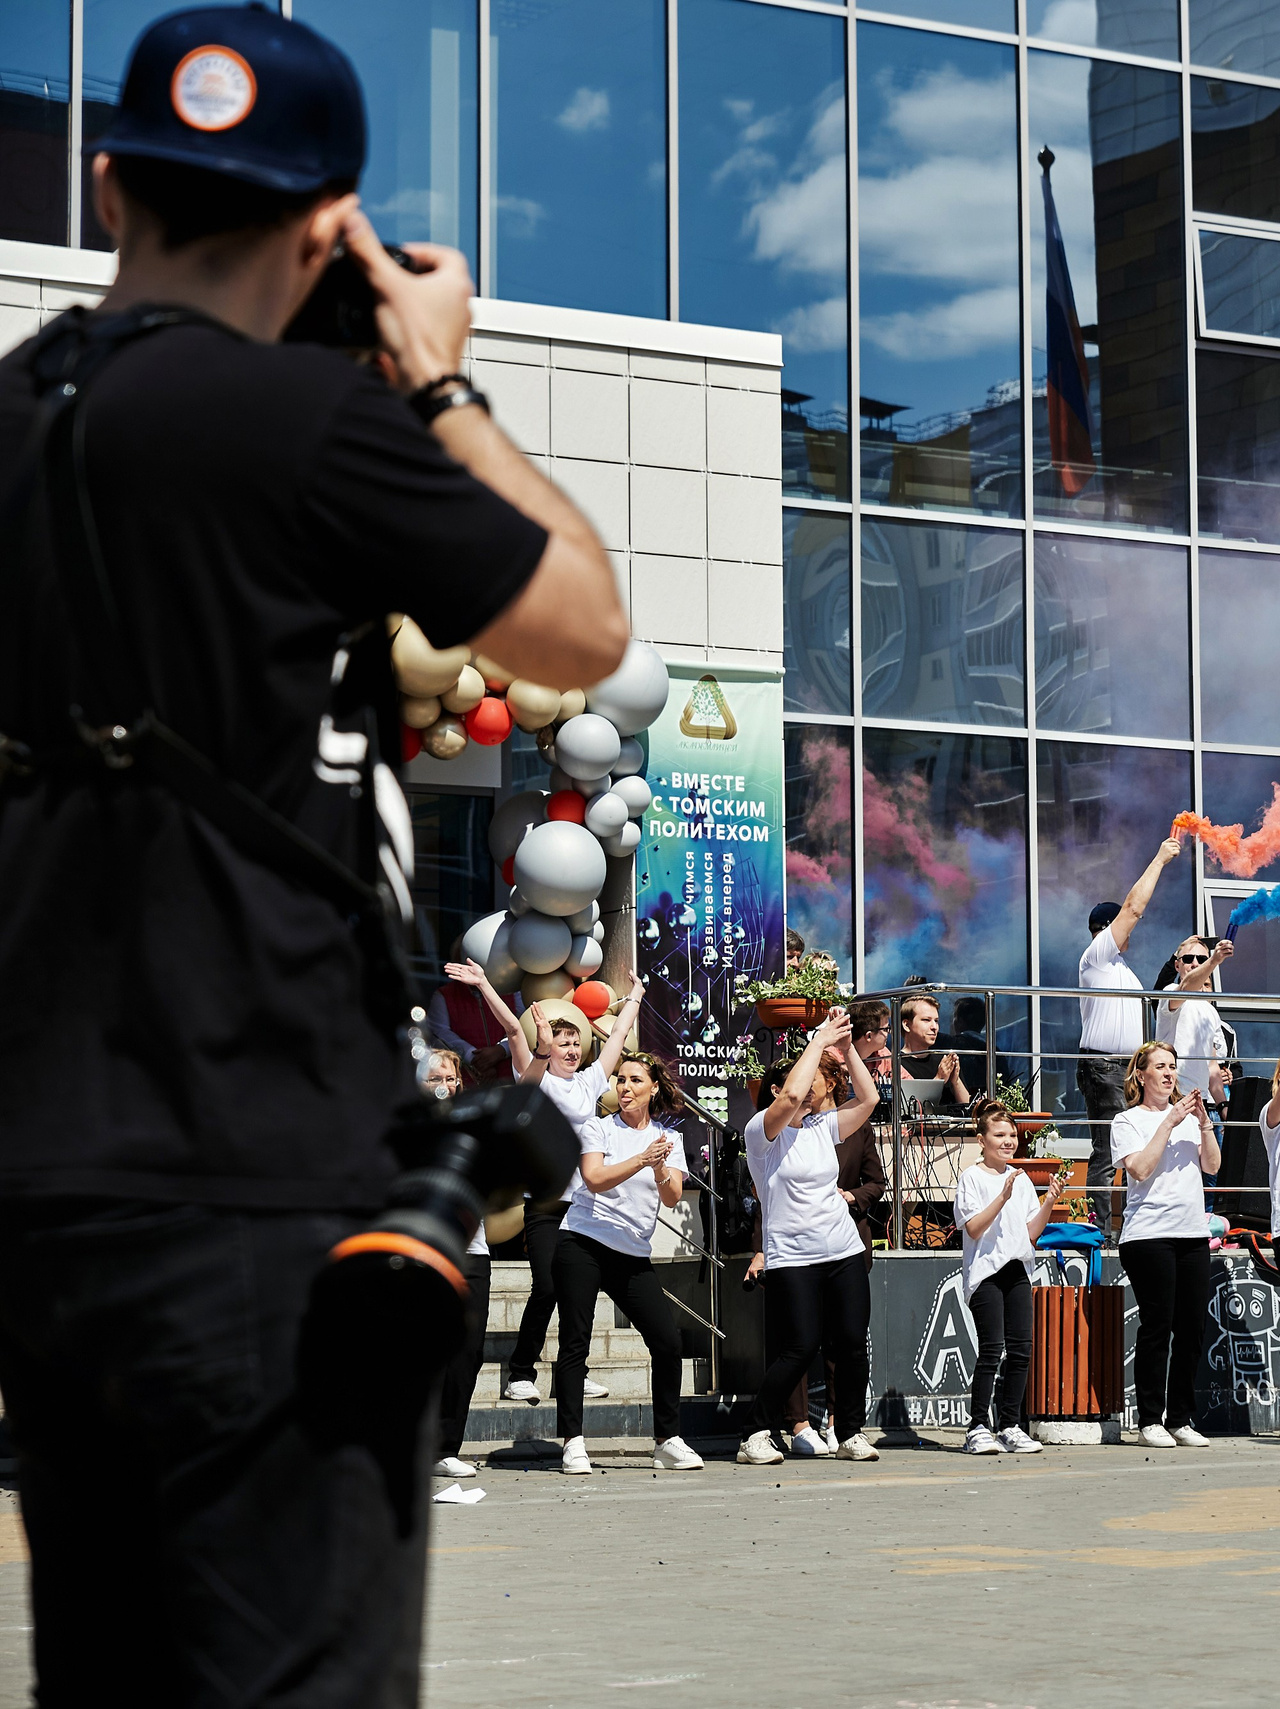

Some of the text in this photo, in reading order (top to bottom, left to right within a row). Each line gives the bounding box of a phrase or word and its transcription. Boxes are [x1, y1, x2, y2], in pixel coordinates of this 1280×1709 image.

[671, 772, 745, 792] ВМЕСТЕ
[652, 796, 765, 817] С ТОМСКИМ
[650, 820, 769, 842] ПОЛИТЕХОМ
[703, 852, 714, 967] Развиваемся
[722, 853, 734, 968] Идем вперед
